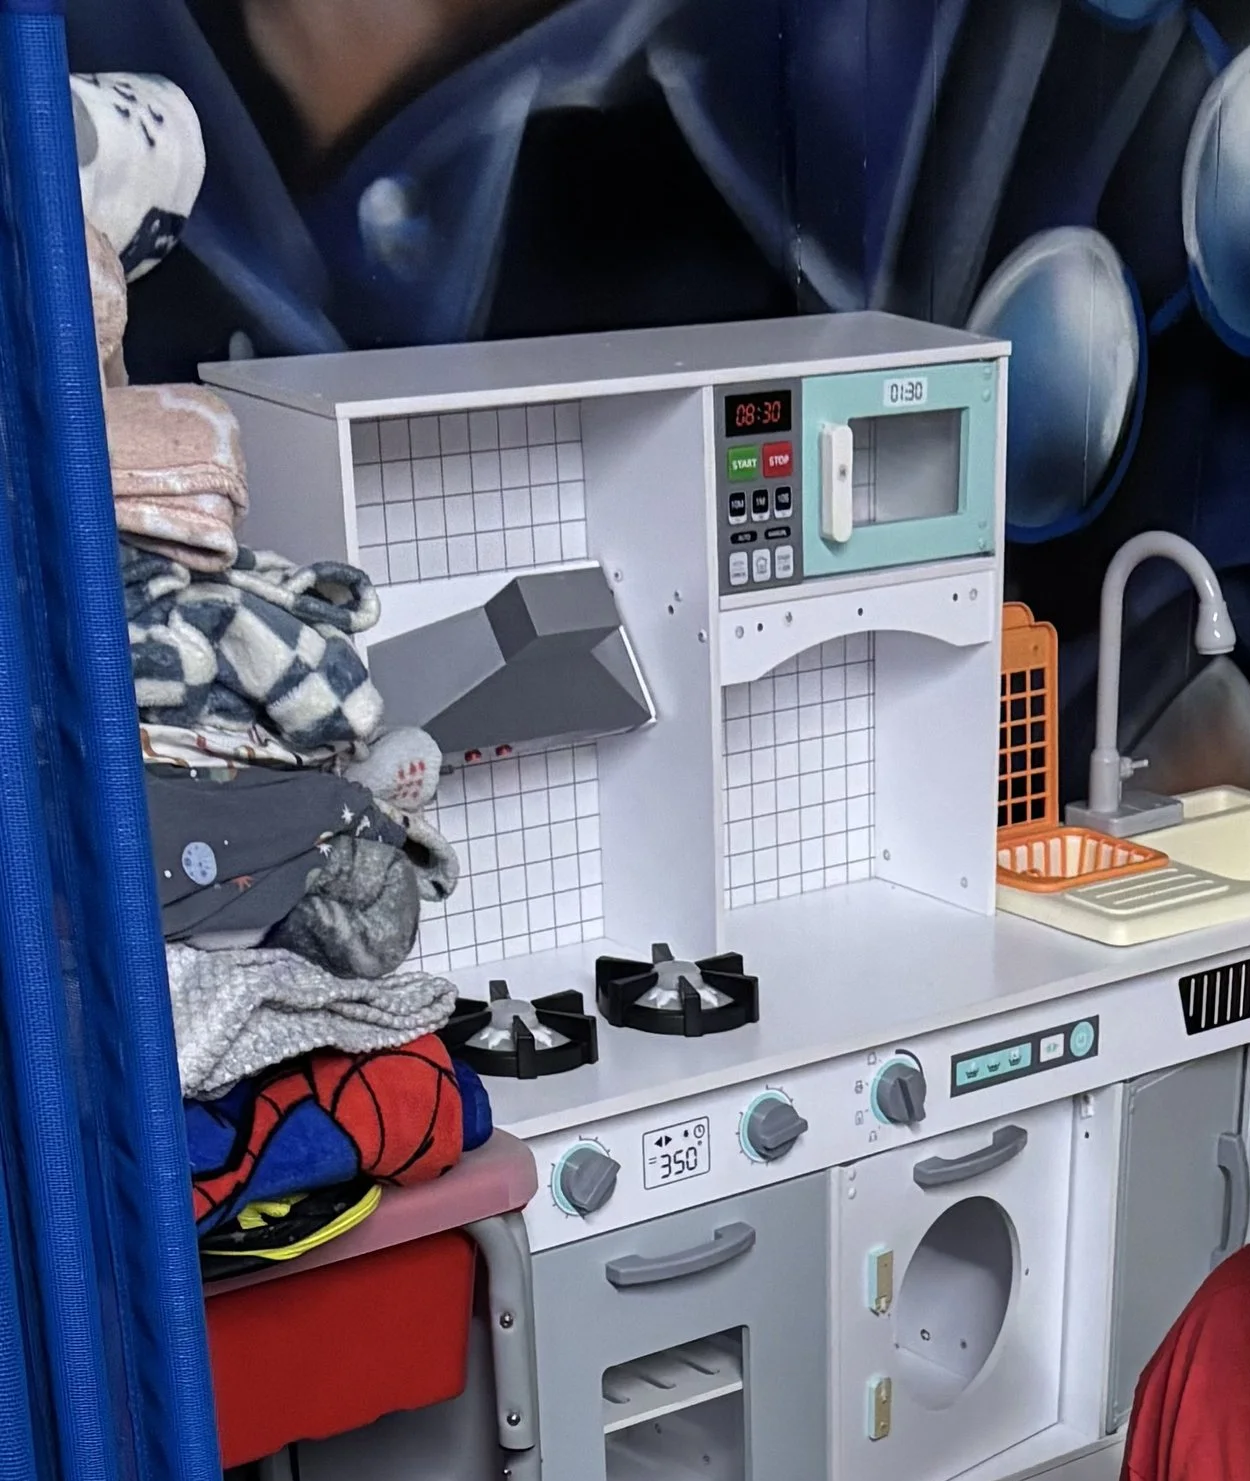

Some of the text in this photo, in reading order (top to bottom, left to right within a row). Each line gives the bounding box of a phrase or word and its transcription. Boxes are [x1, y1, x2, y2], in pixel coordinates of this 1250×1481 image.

[735, 400, 781, 427] 08:30
[731, 457, 758, 471] START
[768, 454, 790, 467] STOP
